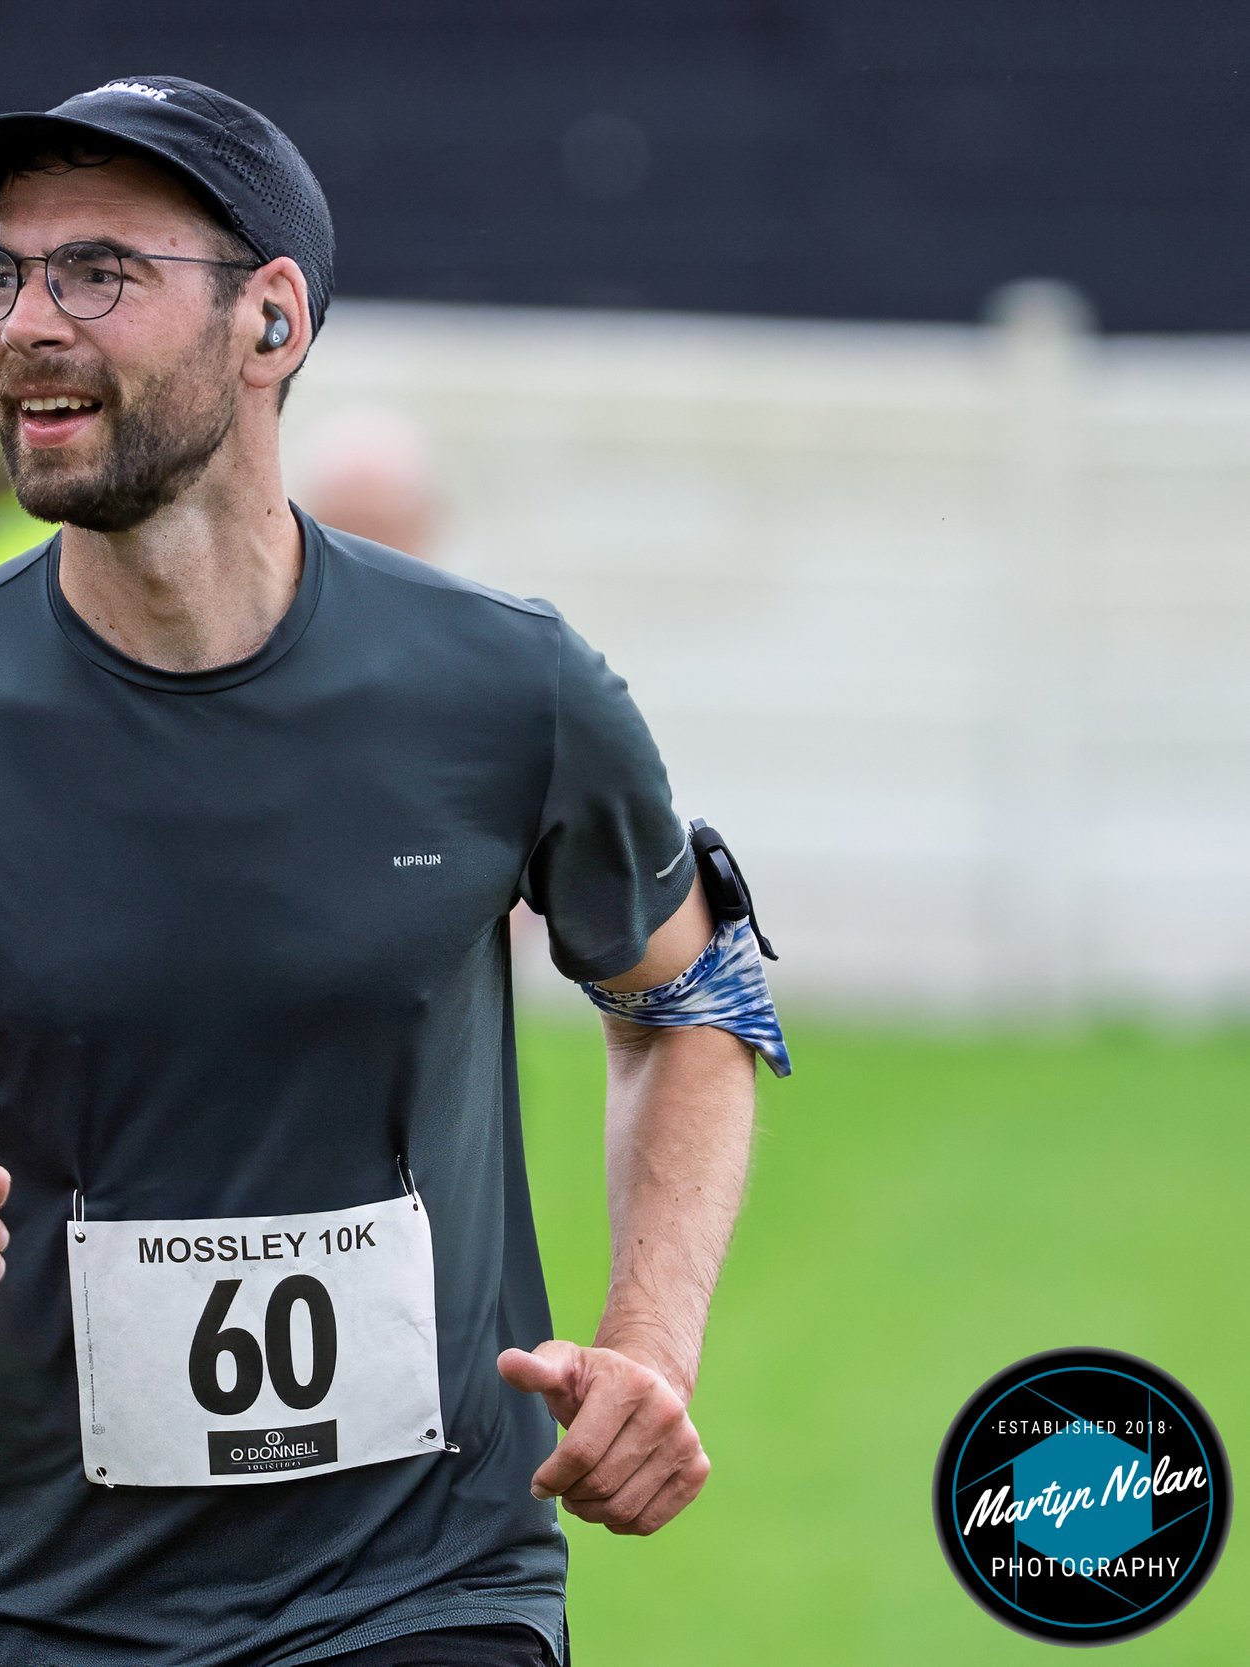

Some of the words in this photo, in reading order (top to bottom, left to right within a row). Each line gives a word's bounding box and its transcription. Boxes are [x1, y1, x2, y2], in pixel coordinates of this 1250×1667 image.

[393, 853, 442, 867] KIPRUN
[138, 1231, 307, 1264] MOSSLEY
[318, 1221, 376, 1255] 10K
[188, 1274, 338, 1416] 60
